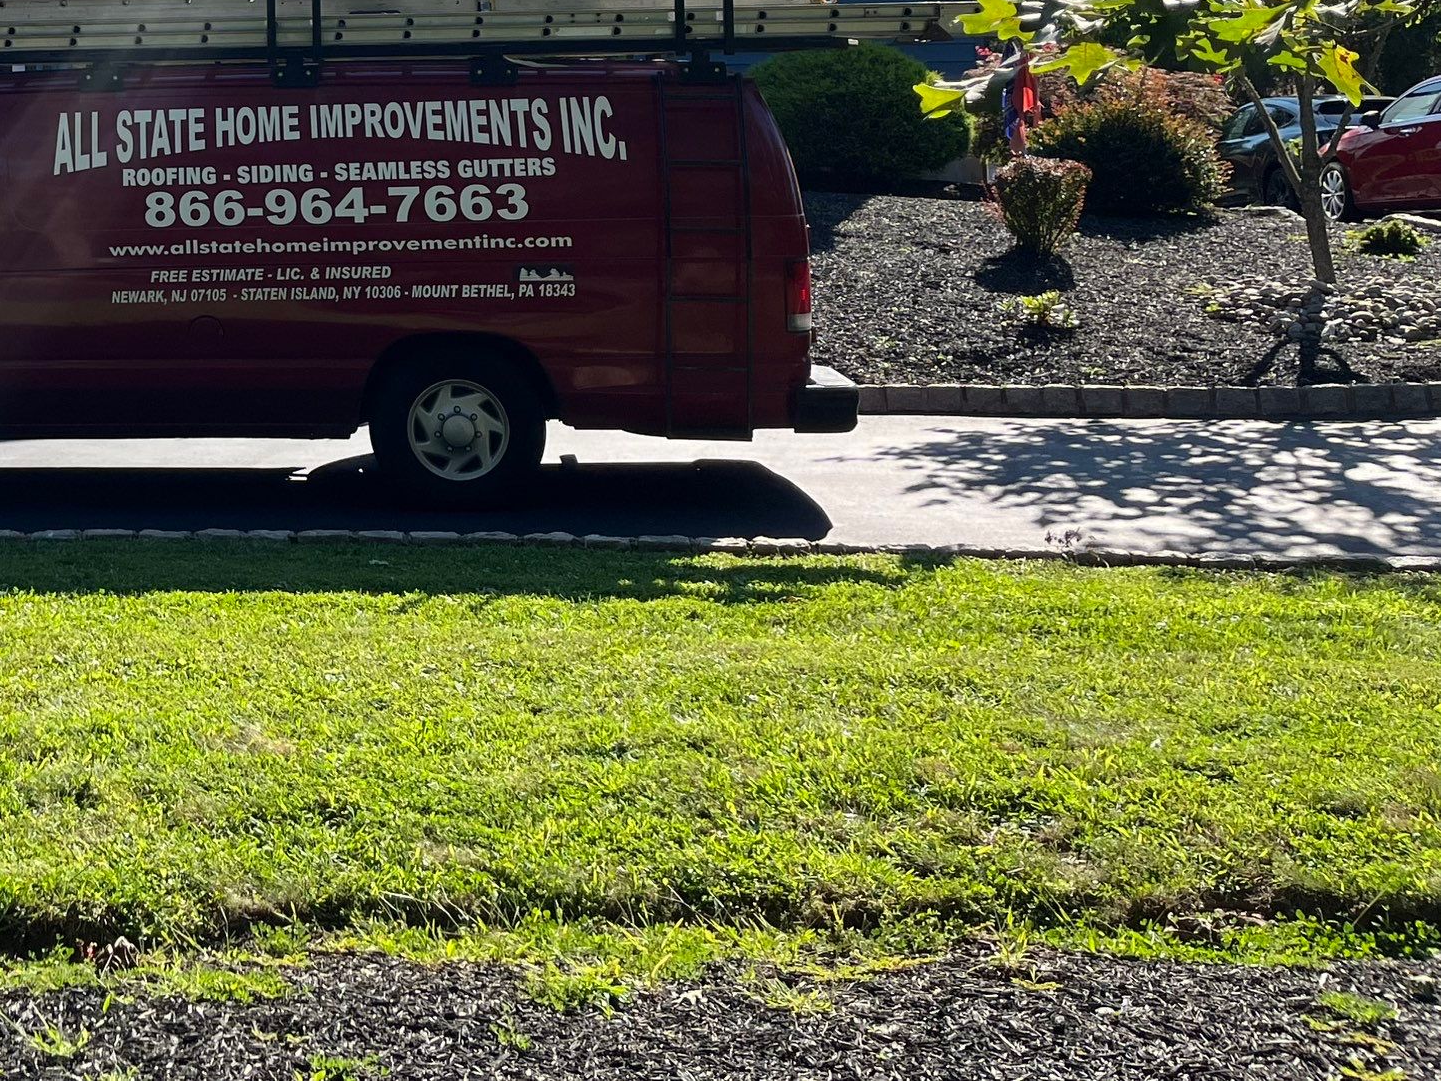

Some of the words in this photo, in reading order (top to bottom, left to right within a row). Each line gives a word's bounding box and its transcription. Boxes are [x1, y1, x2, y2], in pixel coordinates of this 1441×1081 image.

[53, 111, 108, 176] ALL
[115, 107, 206, 164] STATE
[215, 105, 301, 148] HOME
[309, 98, 552, 151] IMPROVEMENTS
[559, 95, 628, 161] INC.
[122, 166, 217, 187] ROOFING
[236, 163, 314, 184] SIDING
[334, 160, 451, 182] SEAMLESS
[457, 157, 556, 179] GUTTERS
[144, 183, 529, 228] 866-964-7663
[108, 233, 573, 257] www.allstatehomeimprovementinc.com
[150, 270, 188, 283] FREE
[191, 268, 265, 282] ESTIMATE
[276, 267, 305, 281] LIC.
[310, 267, 321, 280] &
[325, 265, 392, 280] INSURED
[111, 289, 168, 305] NEWARK,
[171, 289, 188, 303] NJ
[190, 288, 227, 302] 07105
[240, 287, 288, 301] STATEN
[290, 286, 340, 303] ISLAND,
[342, 285, 362, 300] NY
[364, 285, 401, 299] 10306
[411, 284, 459, 298] MOUNT
[461, 284, 515, 301] BETHEL,
[518, 283, 535, 298] PA
[537, 283, 576, 297] 18343
